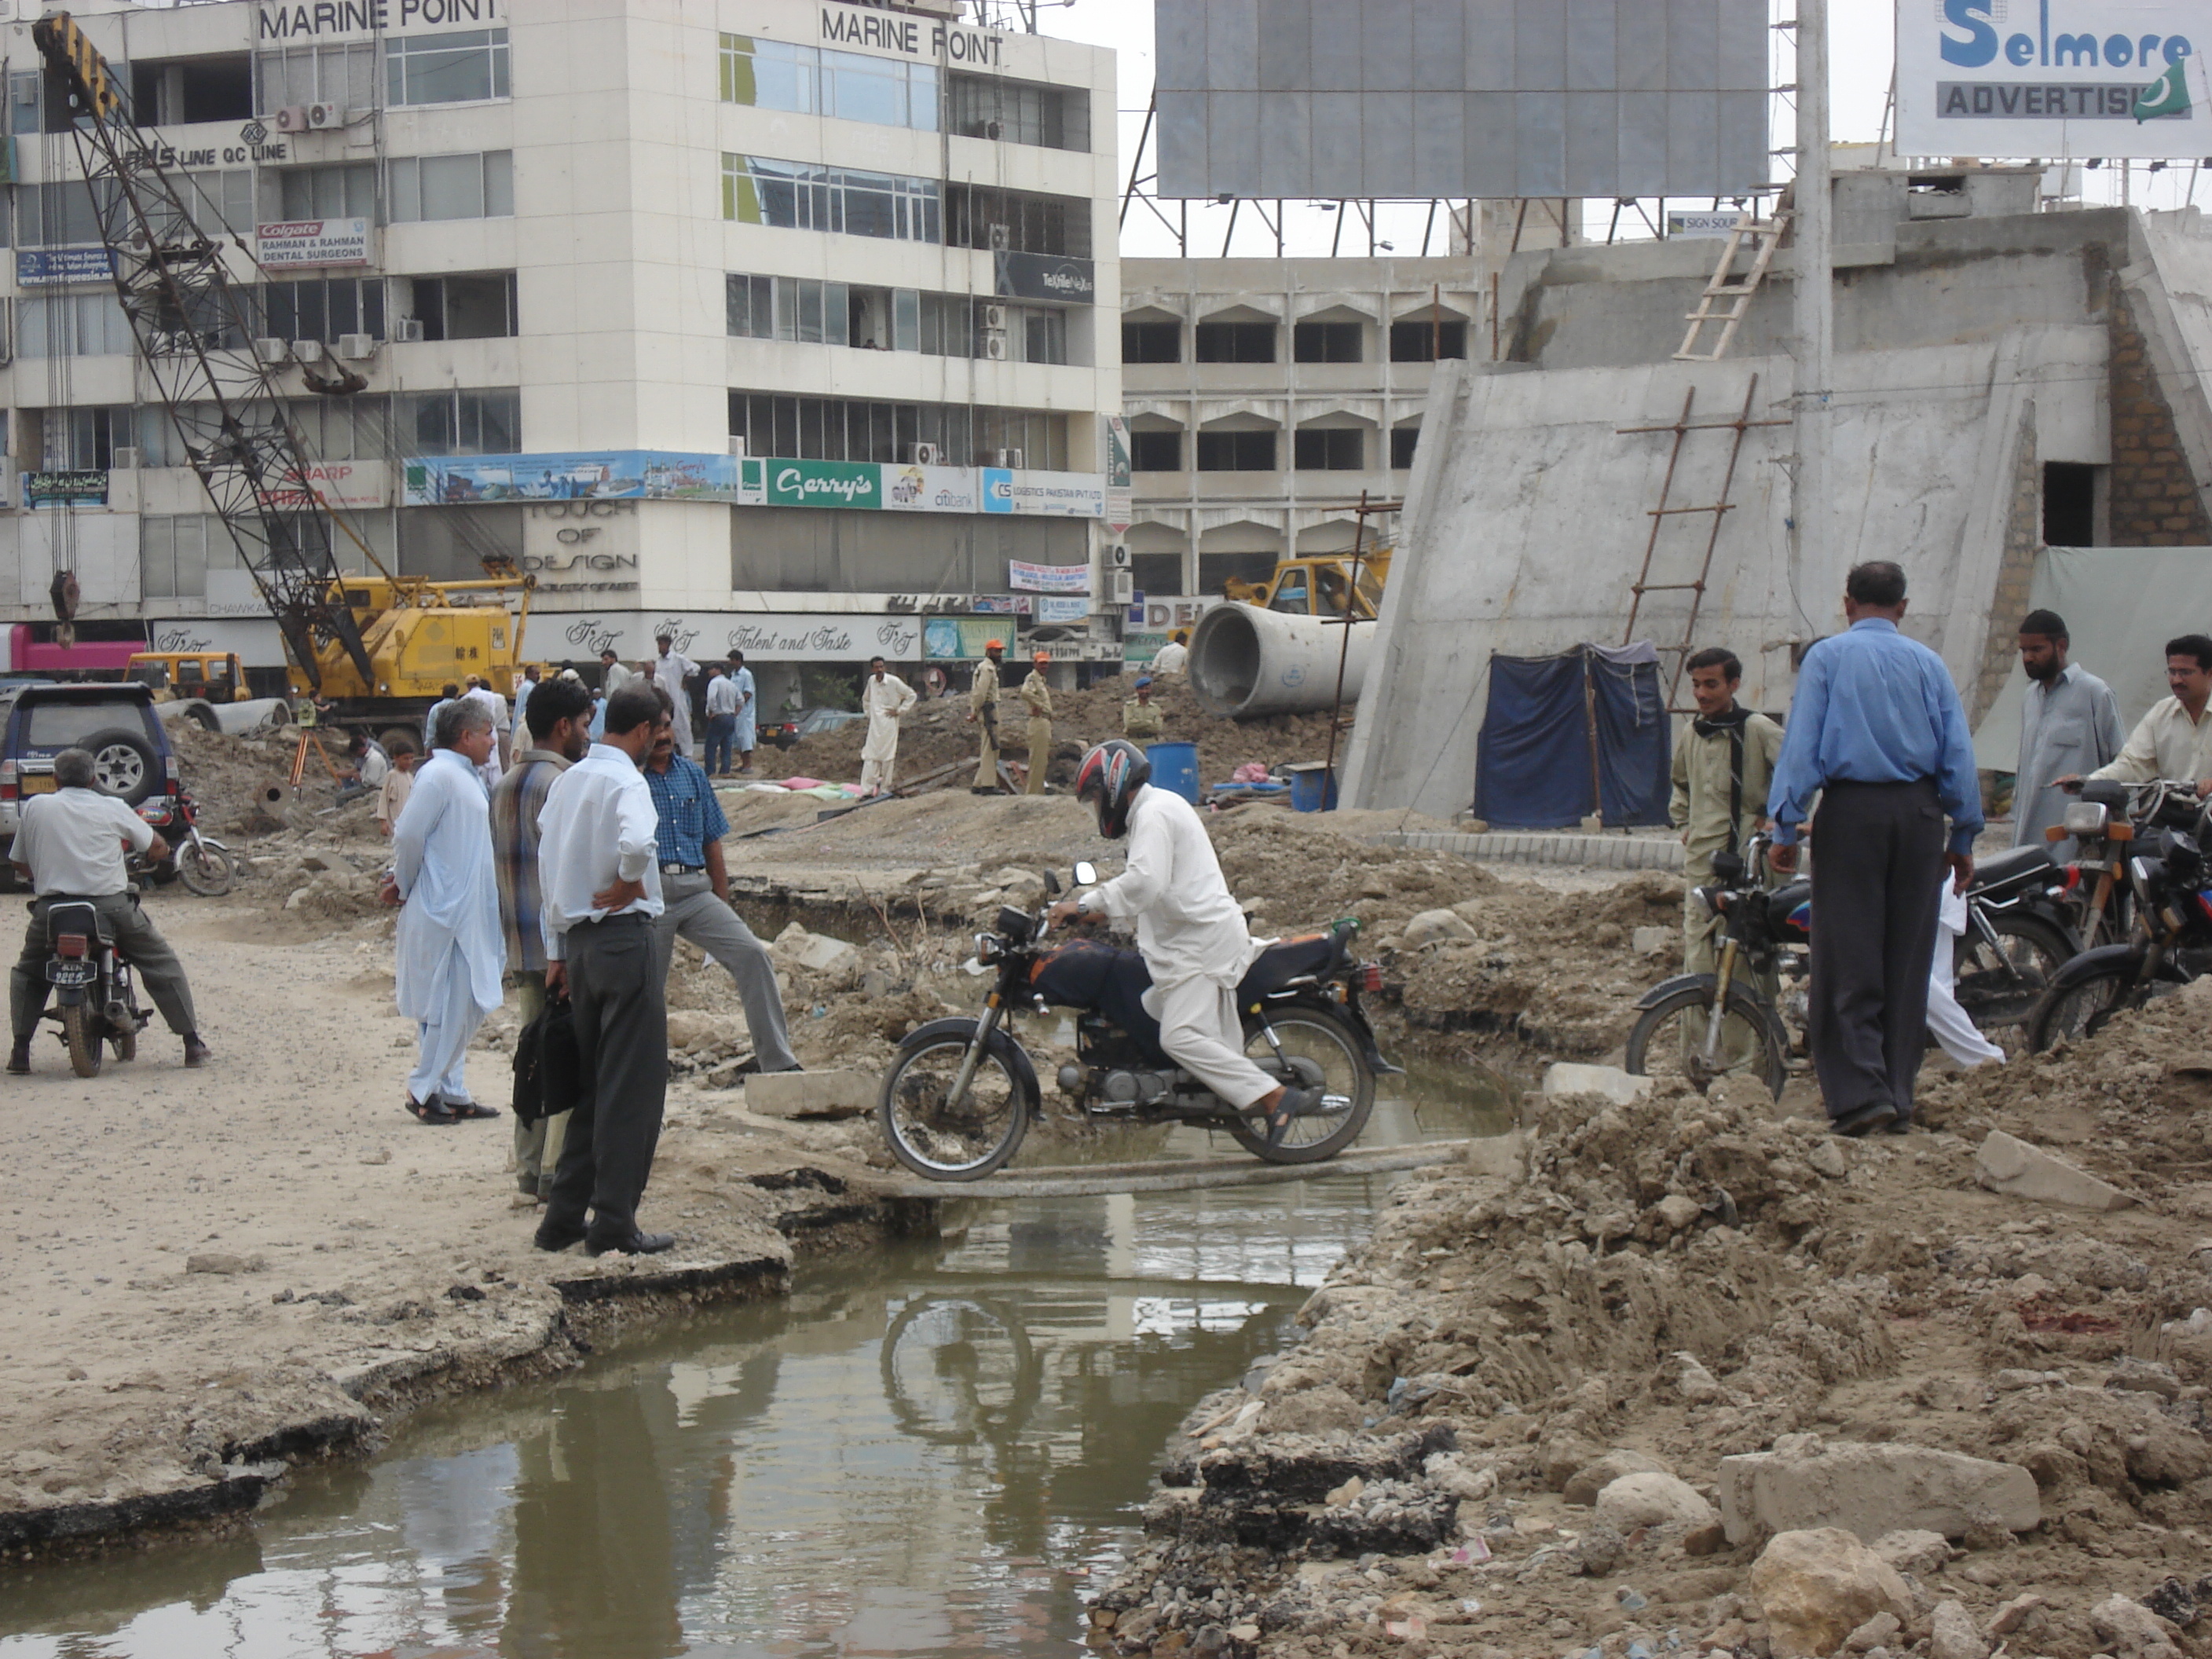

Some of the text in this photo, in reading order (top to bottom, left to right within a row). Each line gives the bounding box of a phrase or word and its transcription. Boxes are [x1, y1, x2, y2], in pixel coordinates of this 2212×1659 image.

[260, 0, 388, 39] MARINE
[822, 8, 1003, 66] MARINE POINT
[1940, 0, 2192, 68] Selmore
[1945, 86, 2183, 115] ADVERTISI
[180, 148, 216, 167] LINE
[223, 147, 246, 163] QC
[251, 144, 287, 161] LINE
[262, 224, 318, 239] Colgate
[1686, 217, 1738, 229] SIGN SOUR
[262, 240, 306, 250] RAHMAN
[320, 236, 364, 247] RAHMAN
[264, 248, 363, 261] DENTAL SURGEONS
[284, 466, 353, 481] SHARP
[775, 467, 873, 502] Gerry's
[998, 484, 1011, 496] CS
[1013, 486, 1044, 496] LOGISTICS
[1046, 488, 1074, 498] PAKISTAN
[935, 489, 972, 507] citibank
[530, 499, 637, 519] TOUCH
[557, 528, 601, 544] OF
[524, 554, 638, 572] DESIGN
[728, 625, 852, 650] Talent and Taste
